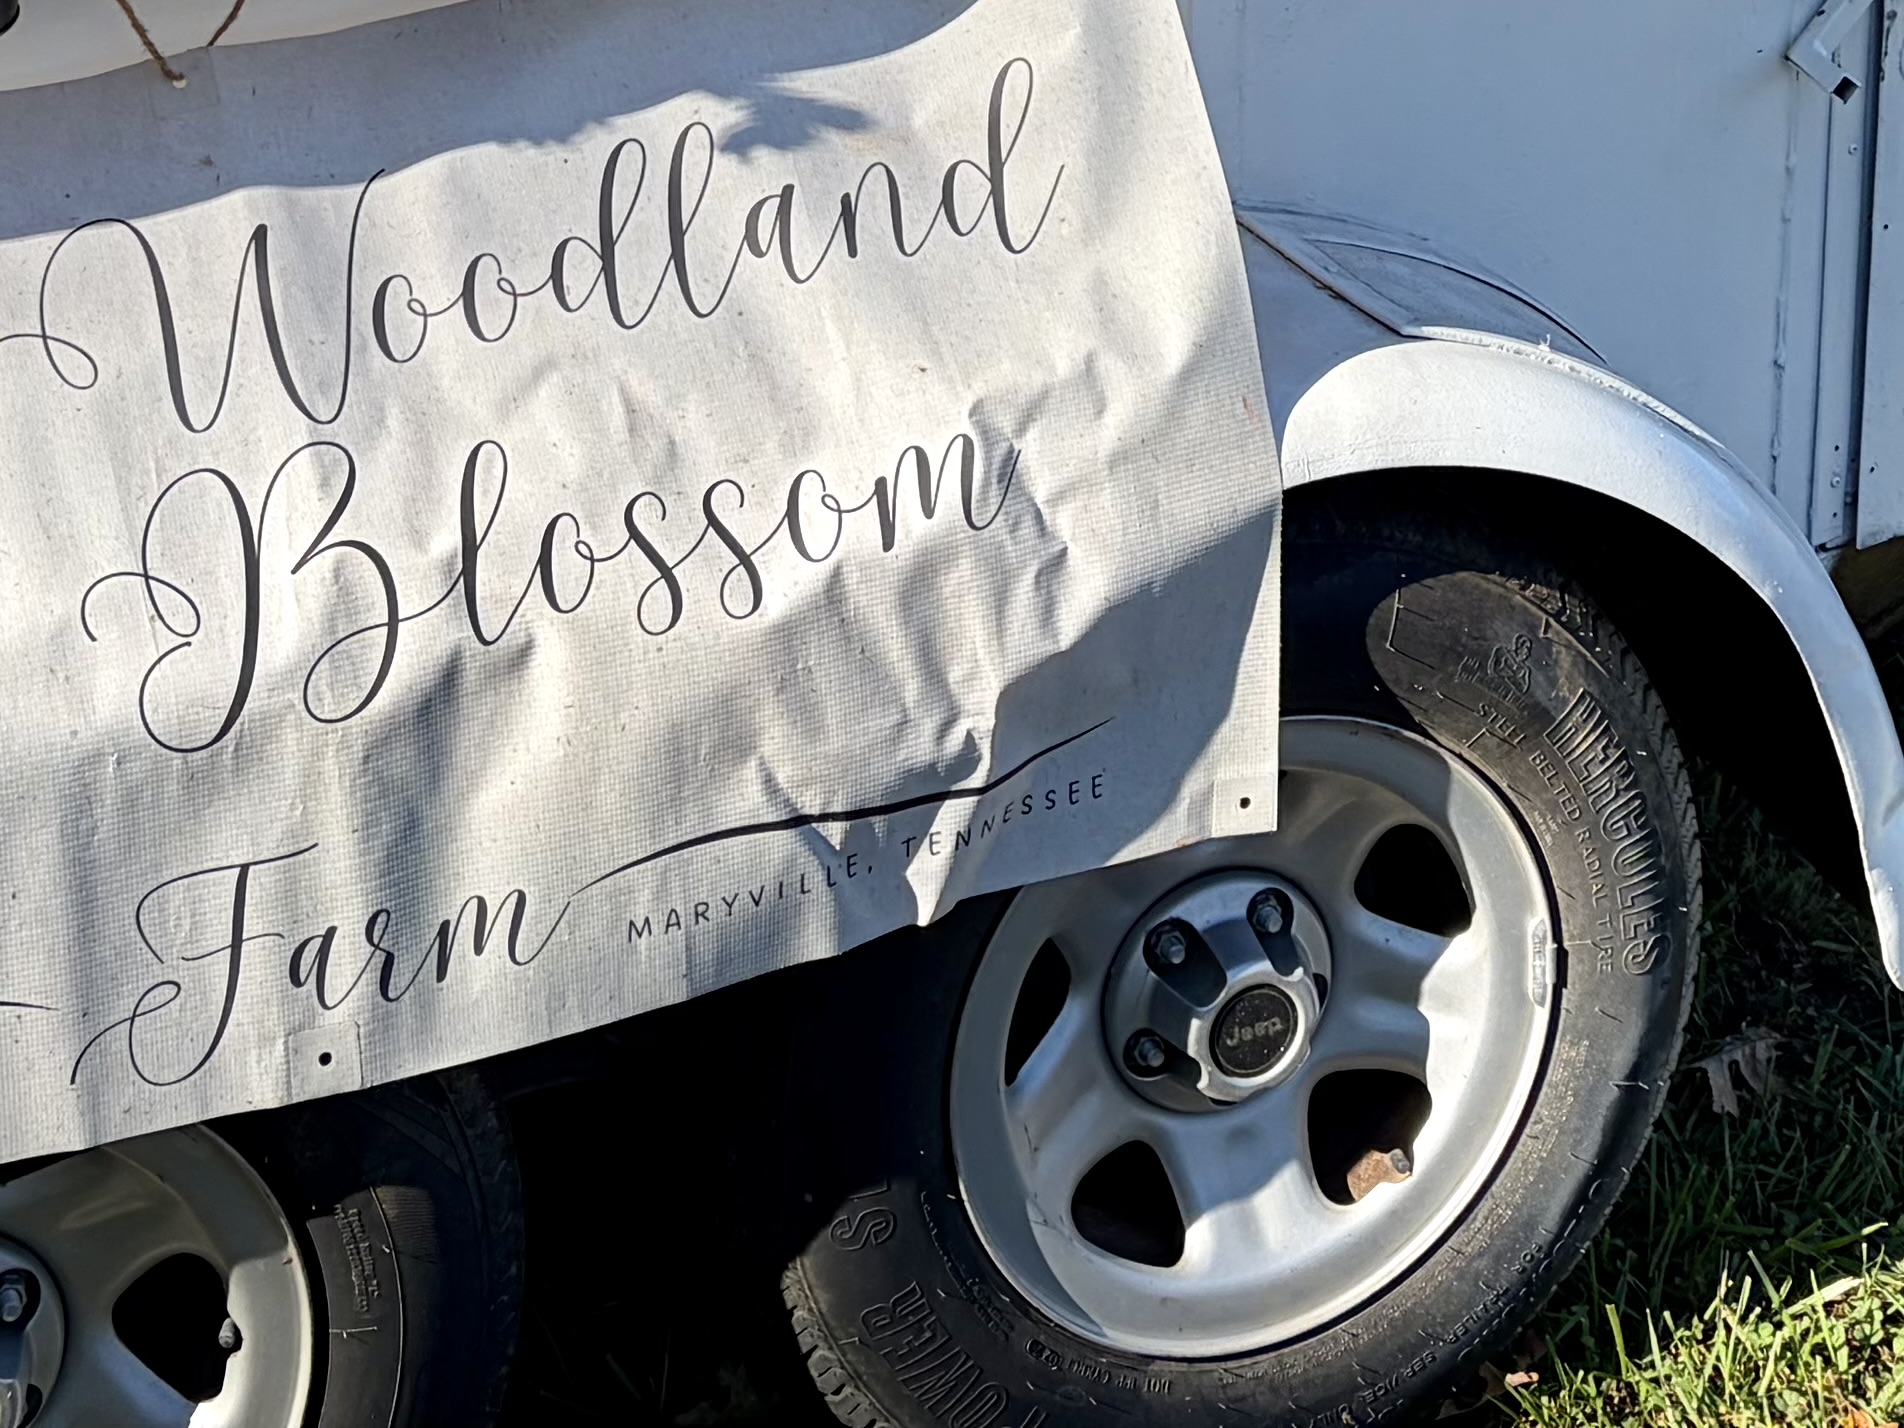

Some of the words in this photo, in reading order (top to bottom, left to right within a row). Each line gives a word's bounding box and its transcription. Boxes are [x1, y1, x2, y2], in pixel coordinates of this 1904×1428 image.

[79, 431, 1021, 752] Blossom
[627, 852, 874, 944] MARYVILLE,
[900, 772, 1105, 859] TENNESSEE
[1477, 702, 1527, 745] STEEL
[1528, 750, 1583, 822] BELTED
[1574, 826, 1612, 909] RADIAL
[1597, 912, 1615, 976] TIRE
[1543, 687, 1671, 977] HERCULES
[70, 842, 572, 1087] Farm
[1223, 1016, 1290, 1049] Jeep
